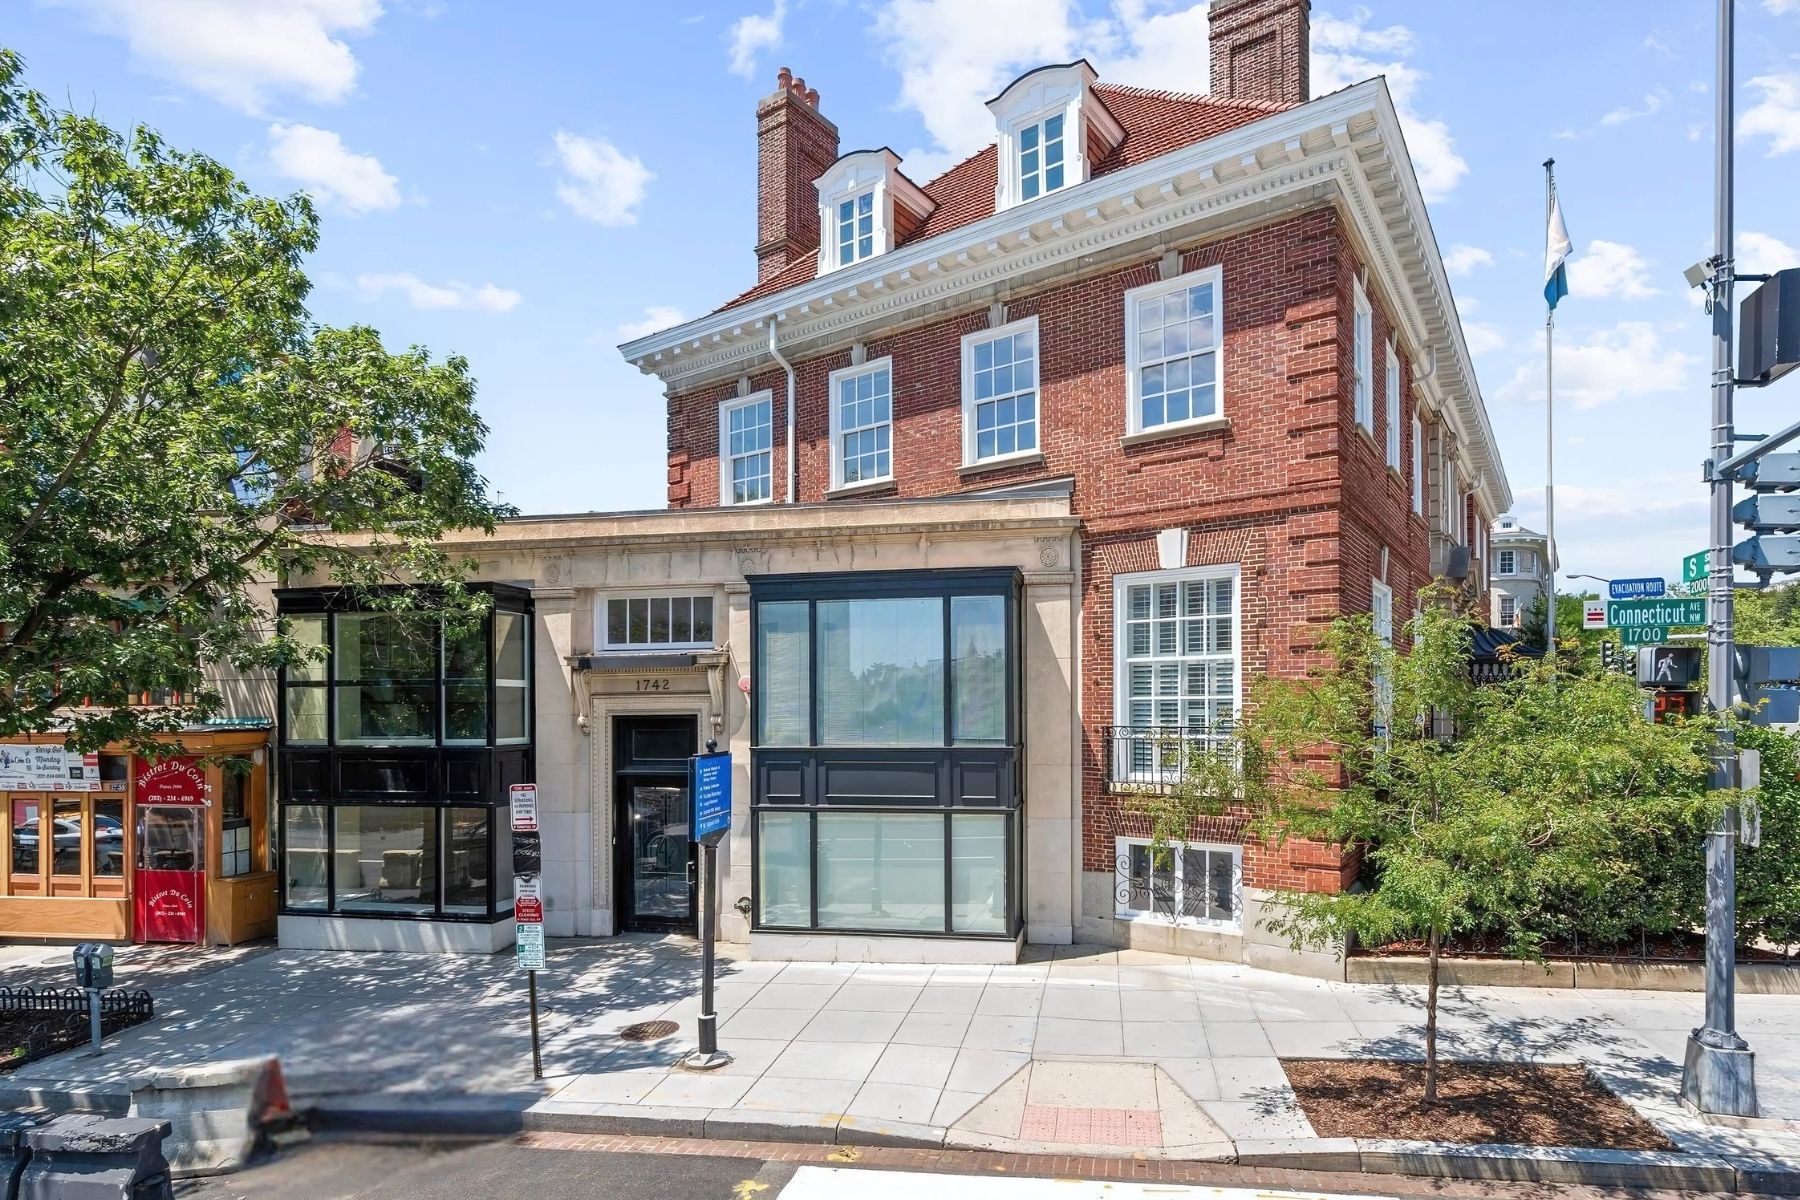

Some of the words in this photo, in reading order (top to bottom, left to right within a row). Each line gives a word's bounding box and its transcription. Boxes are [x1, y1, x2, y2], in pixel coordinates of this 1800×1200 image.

[1689, 557, 1697, 578] S
[1611, 582, 1645, 595] EVACUATION
[1646, 581, 1663, 593] ROUTE
[1690, 578, 1708, 594] 2000
[1689, 602, 1701, 611] AVE
[1610, 603, 1686, 625] Connecticut
[1689, 613, 1701, 622] NW
[1628, 628, 1661, 642] 1700
[636, 679, 670, 691] 1742
[138, 763, 167, 789] Bistrot
[170, 761, 186, 772] Du
[186, 768, 204, 790] Coin
